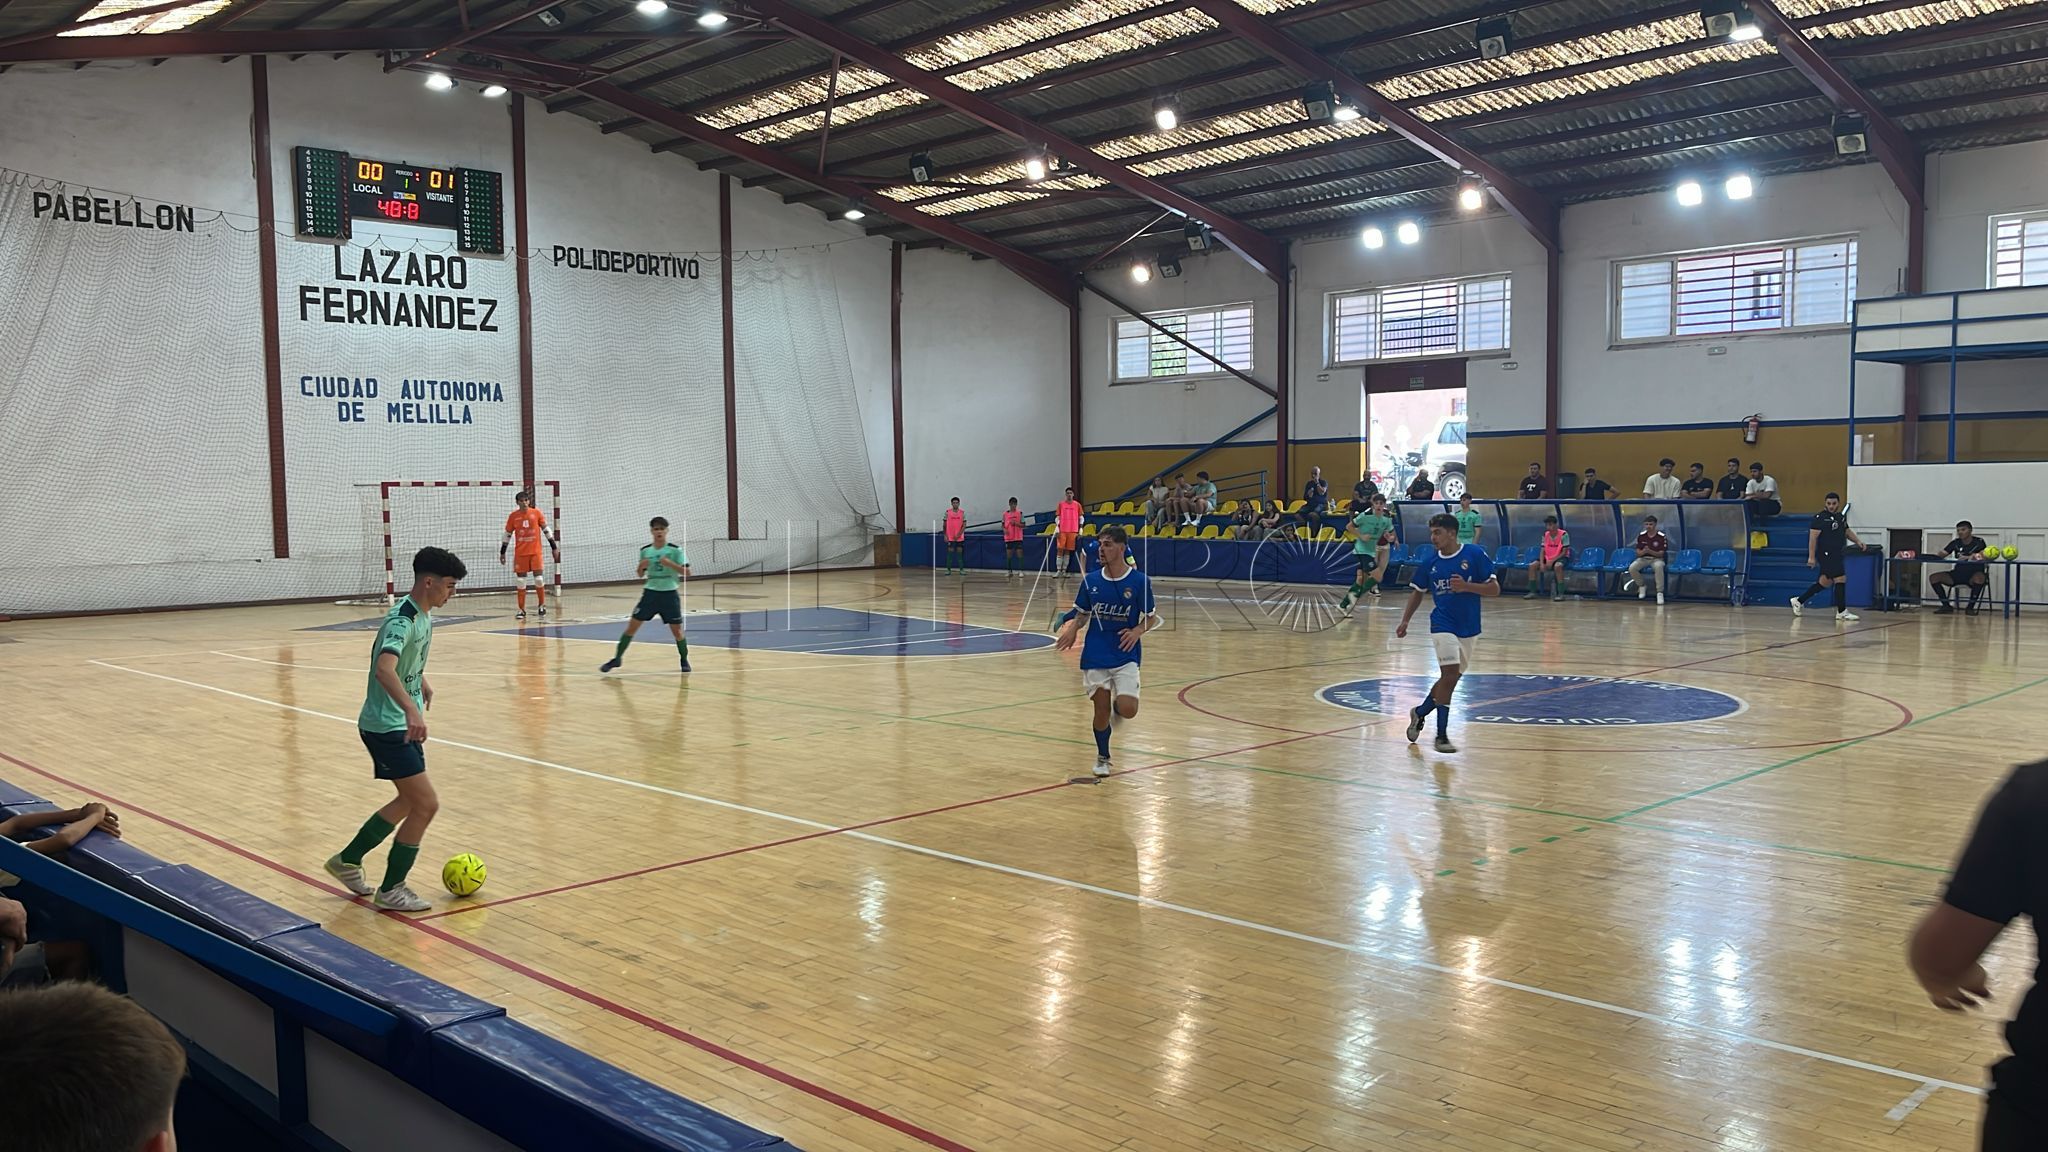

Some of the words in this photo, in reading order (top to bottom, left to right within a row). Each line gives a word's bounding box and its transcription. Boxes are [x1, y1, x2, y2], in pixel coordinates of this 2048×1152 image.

[359, 162, 383, 180] 00
[430, 171, 453, 189] 01
[353, 183, 383, 194] LOCAL
[426, 192, 454, 203] VISITANTE
[33, 192, 194, 232] PABELLON
[334, 244, 468, 289] LAZARO
[553, 245, 699, 279] POLIDEPORTIVO
[300, 285, 498, 332] FERNANDEZ
[300, 376, 378, 398] CIUDAD
[401, 380, 503, 402] AUTONOMA
[338, 402, 365, 422] DE
[387, 403, 472, 424] MELILLA
[1091, 602, 1132, 616] MELILLA
[1475, 715, 1638, 724] CIUDAD
